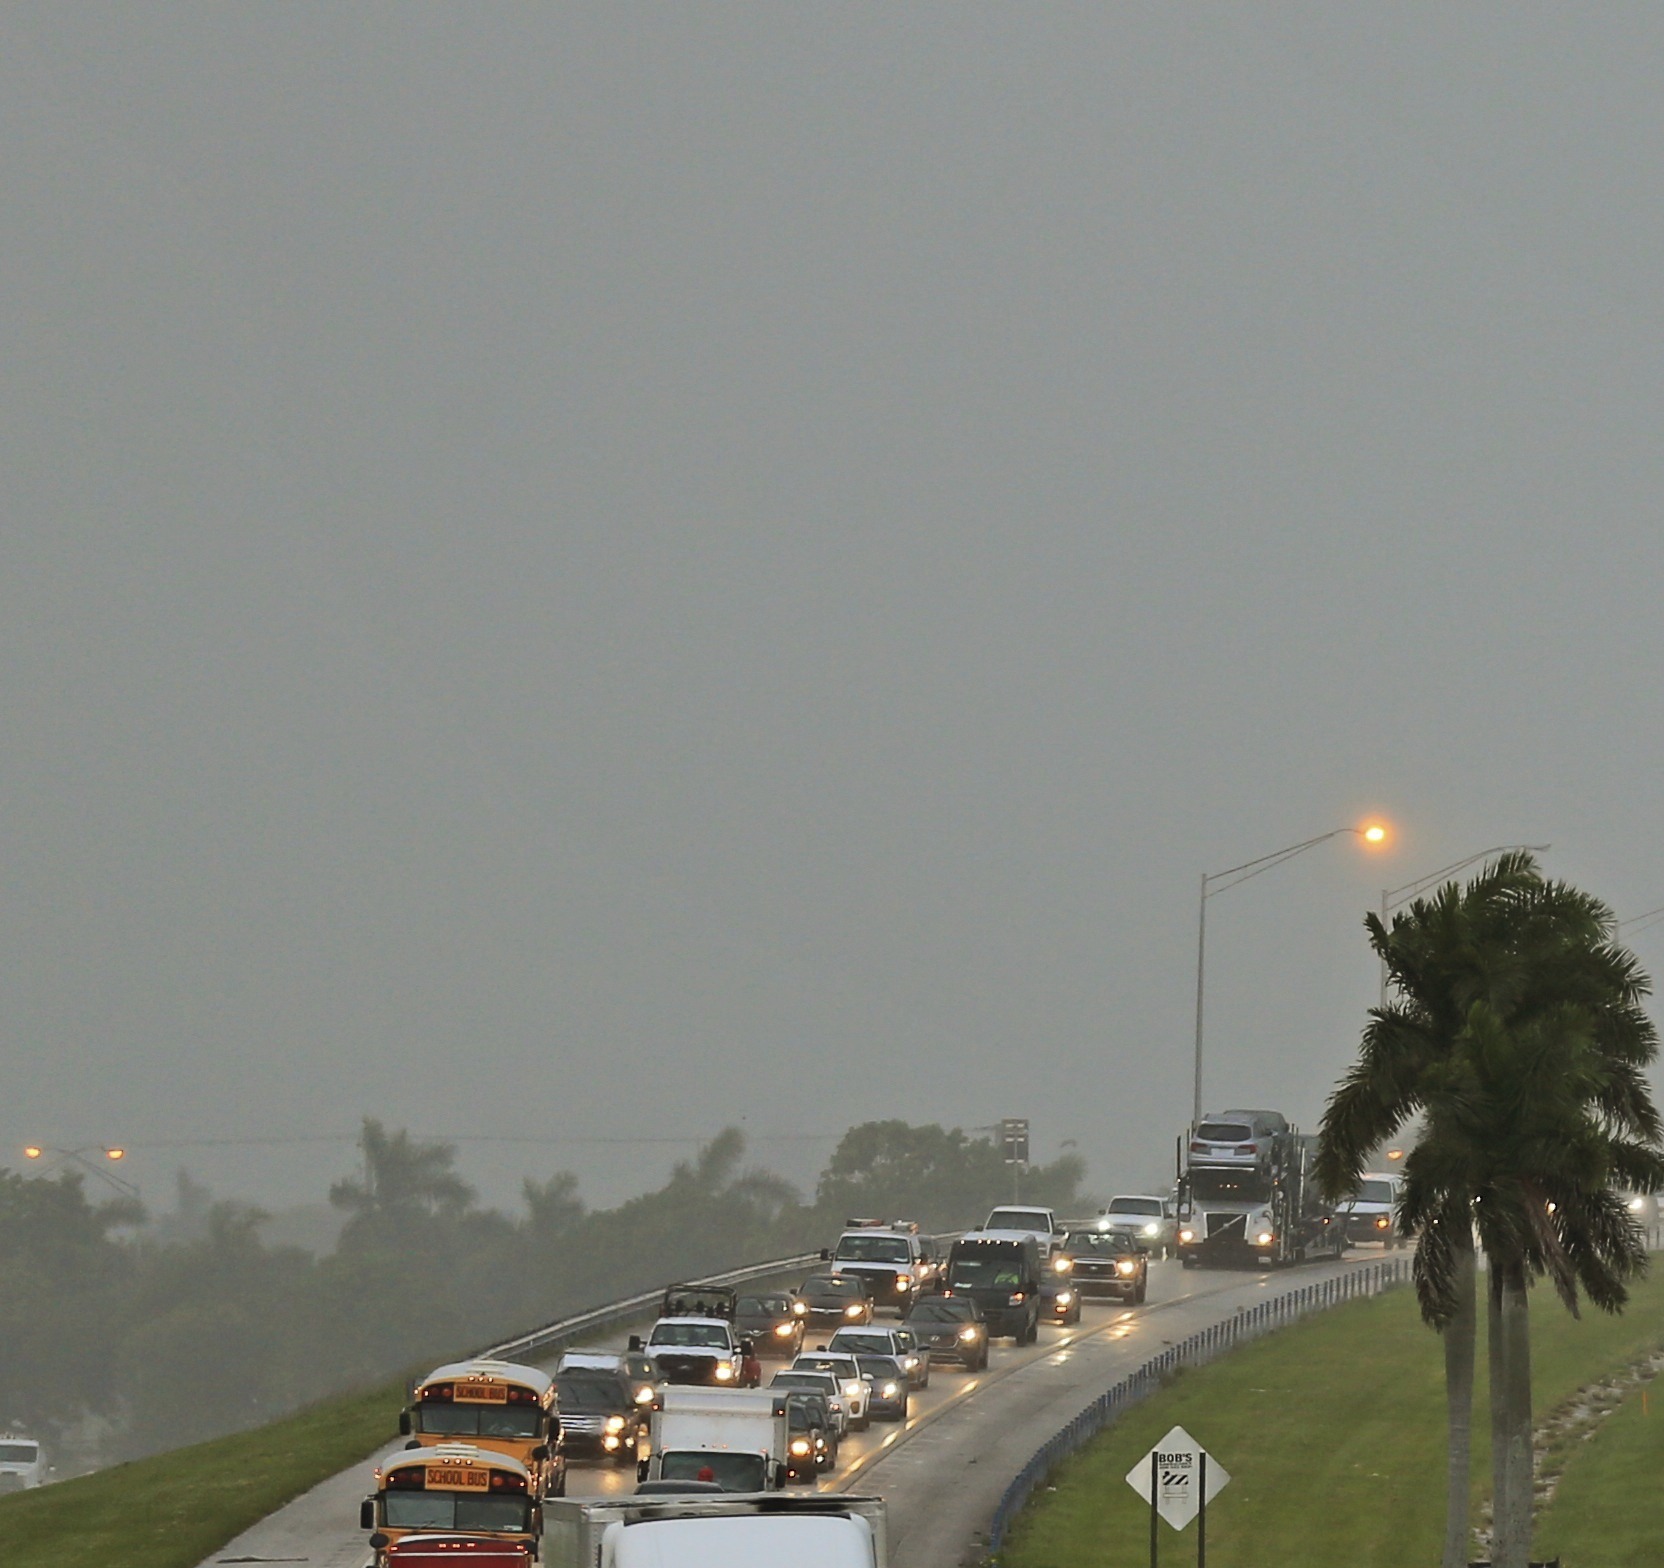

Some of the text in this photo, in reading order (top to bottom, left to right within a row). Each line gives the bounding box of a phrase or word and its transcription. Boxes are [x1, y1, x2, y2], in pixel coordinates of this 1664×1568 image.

[456, 1385, 506, 1400] SCHOOL BUS
[1158, 1453, 1193, 1463] BOB'S
[427, 1469, 488, 1487] SCHOOL BUS
